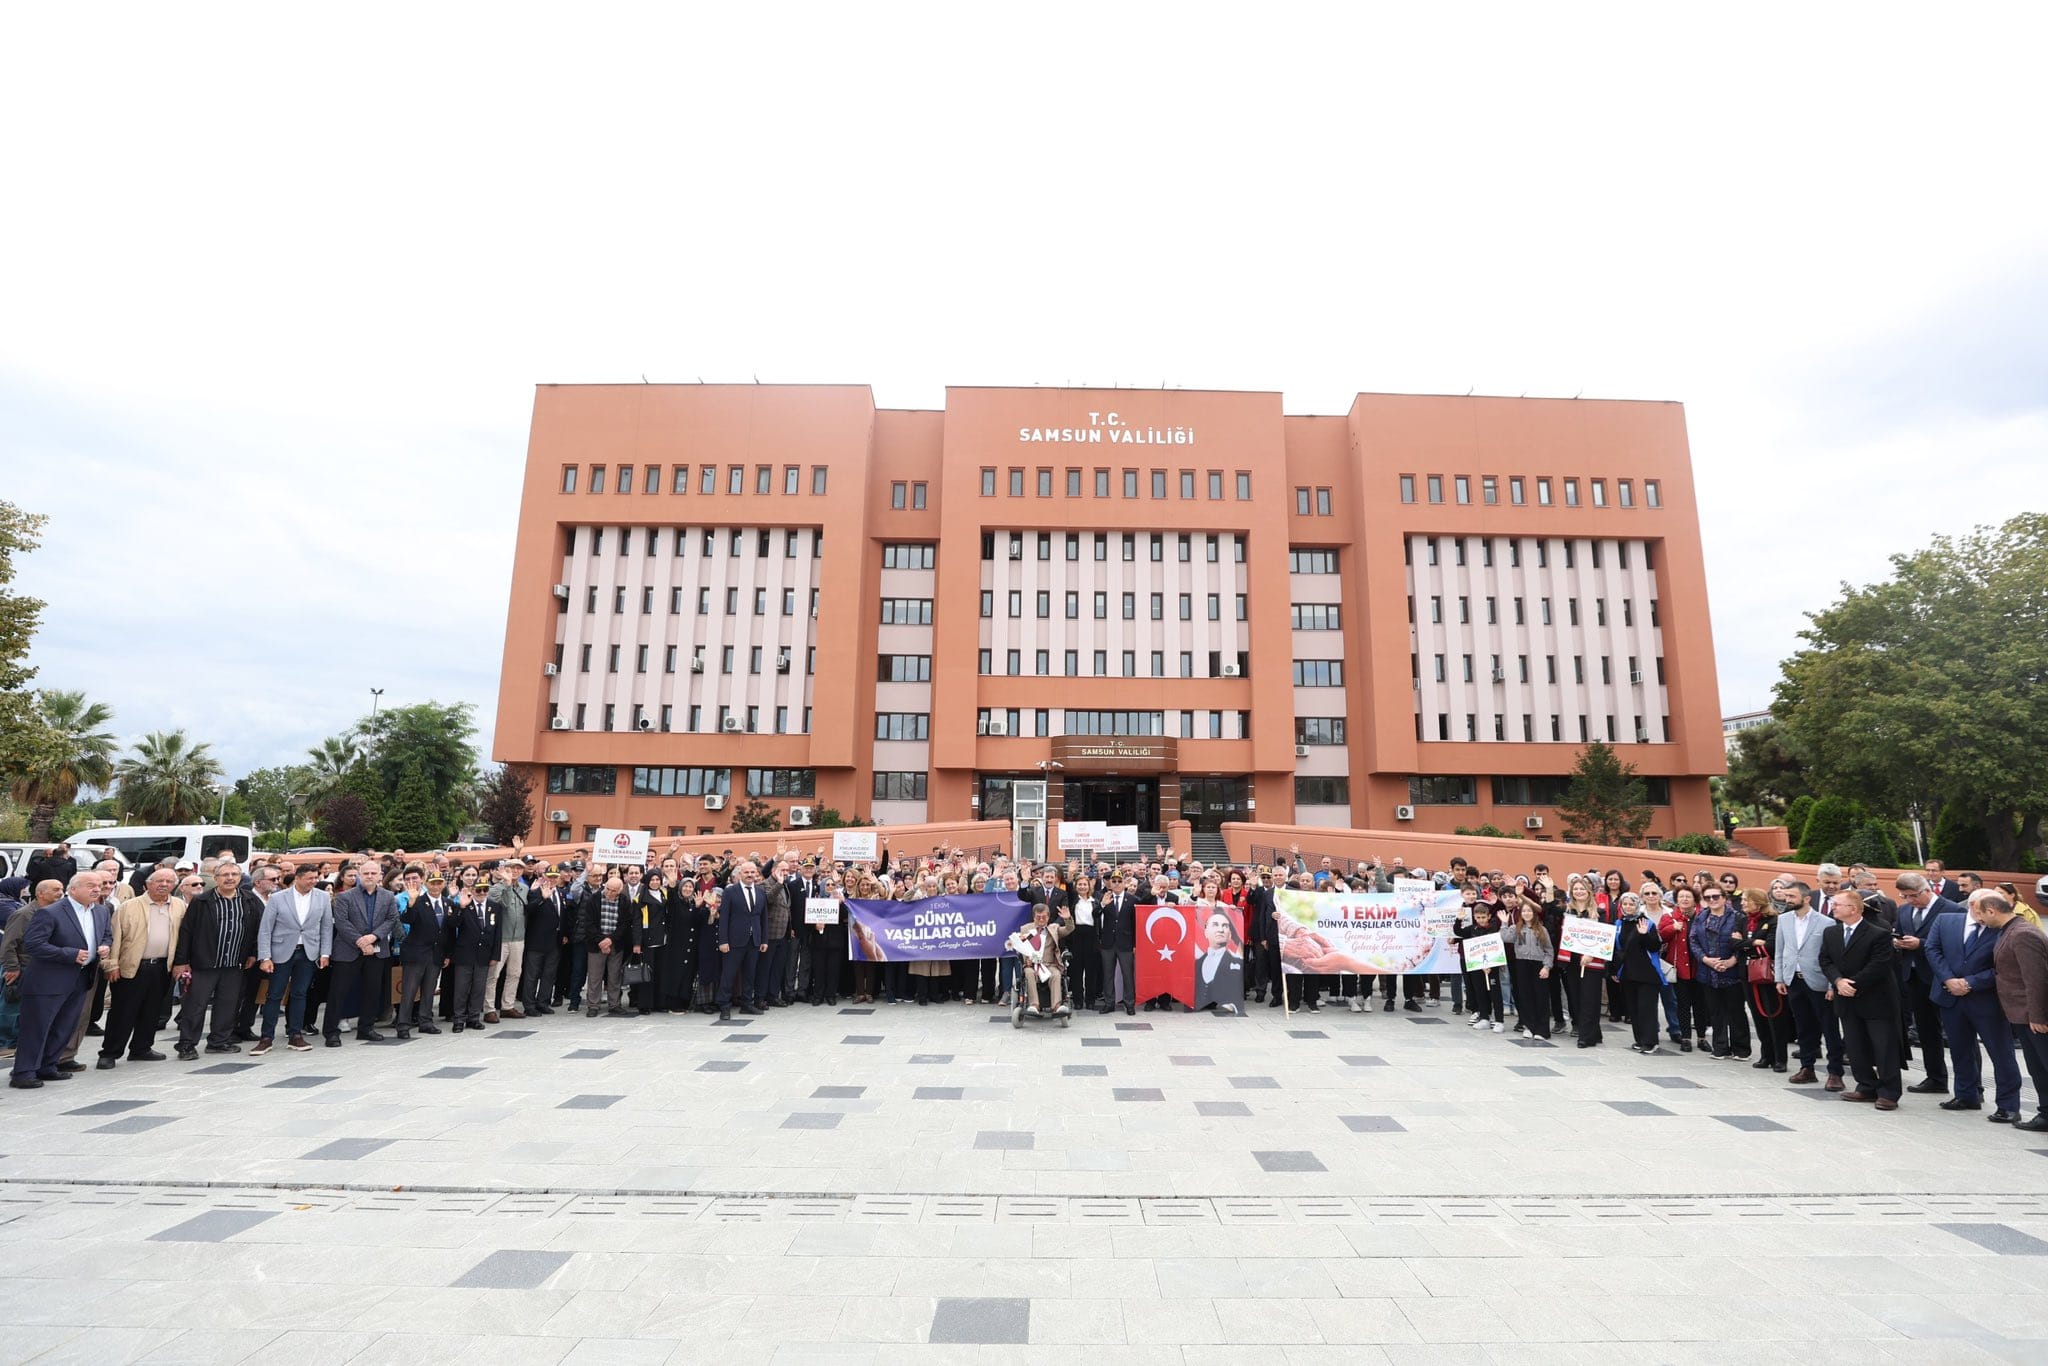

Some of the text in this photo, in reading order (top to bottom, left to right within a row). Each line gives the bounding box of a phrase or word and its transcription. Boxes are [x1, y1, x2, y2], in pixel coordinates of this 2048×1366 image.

[1089, 412, 1126, 426] T.C.
[1019, 427, 1194, 444] SAMSUN VALİLİĞİ
[1081, 747, 1151, 756] SAMSUN VALİLİĞİ
[914, 910, 965, 927] DÜNYA
[1341, 904, 1397, 920] 1 EKİM
[884, 920, 997, 944] YAŞLILAR GÜNÜ
[1317, 918, 1421, 931] DÜNYA YAŞLILAR GÜNÜ
